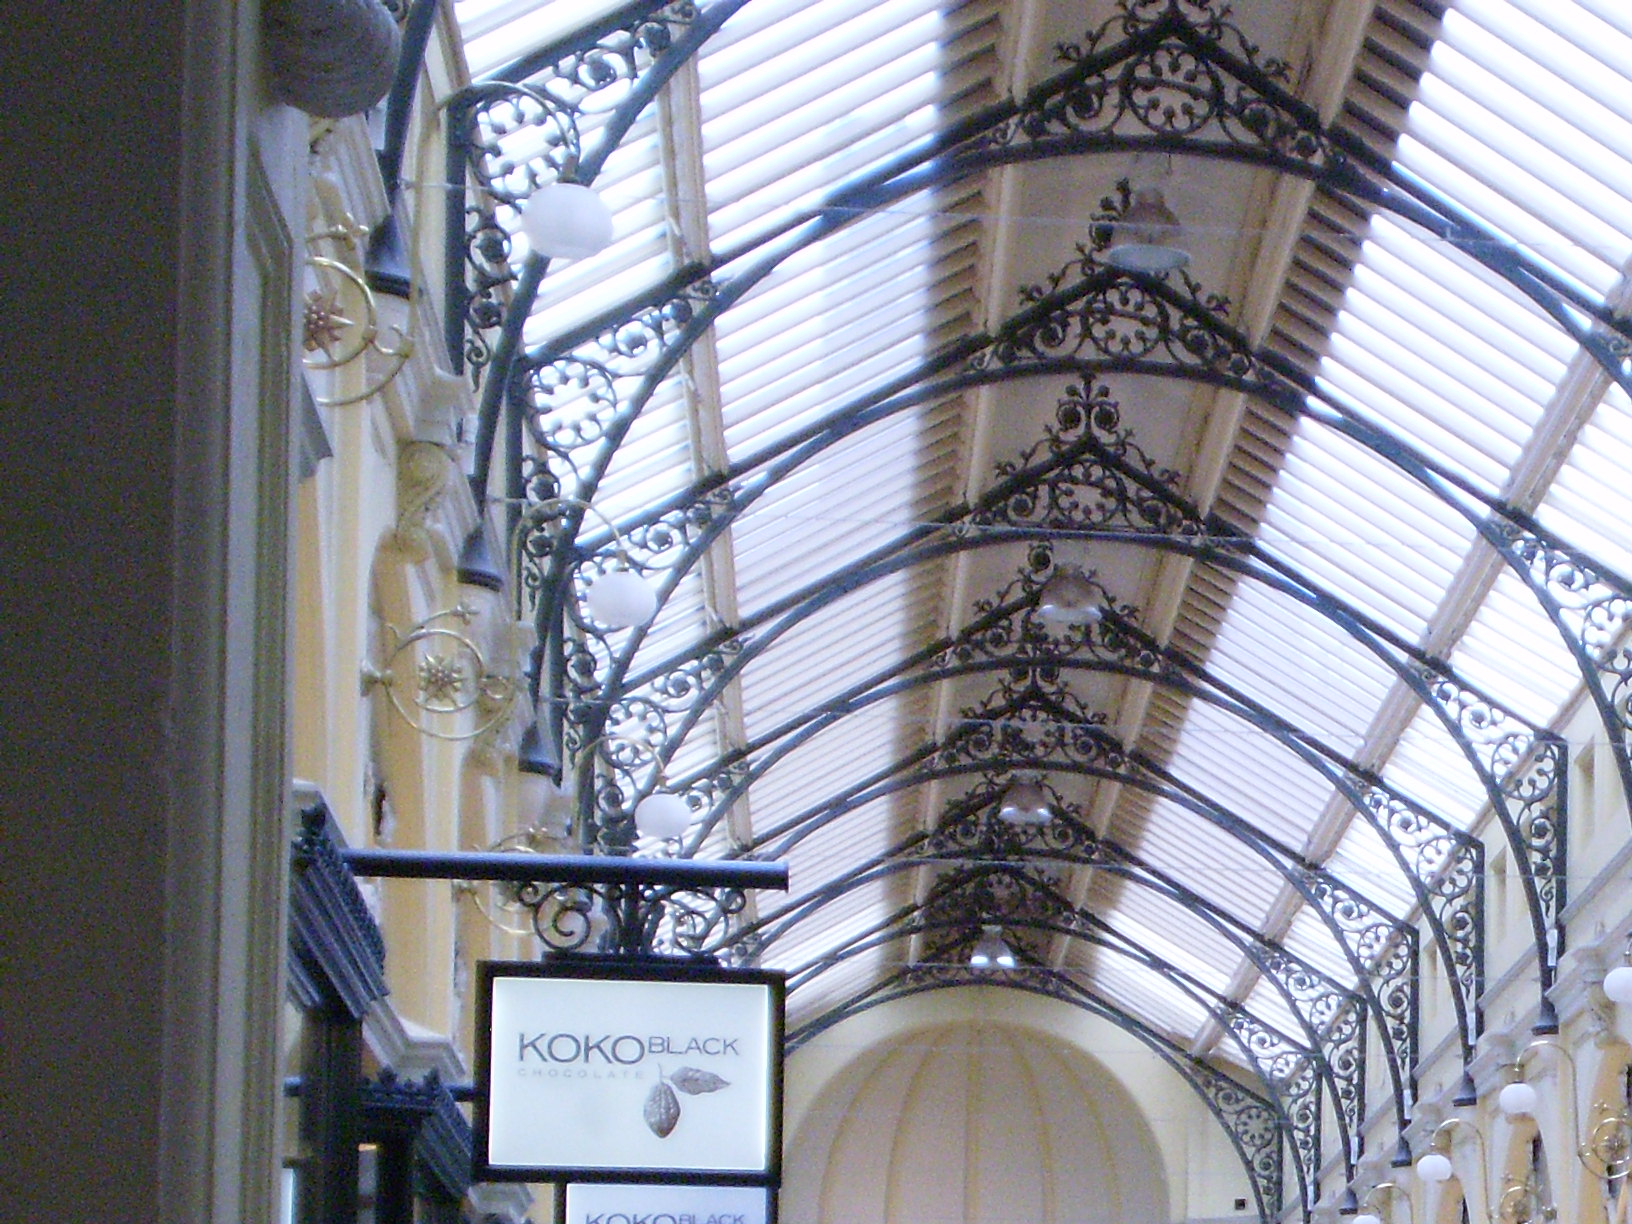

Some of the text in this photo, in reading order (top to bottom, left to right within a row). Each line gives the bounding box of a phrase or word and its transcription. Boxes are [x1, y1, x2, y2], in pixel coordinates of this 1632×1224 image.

[518, 1032, 740, 1065] KOKO BLACK
[517, 1067, 645, 1080] CHOCOLATE
